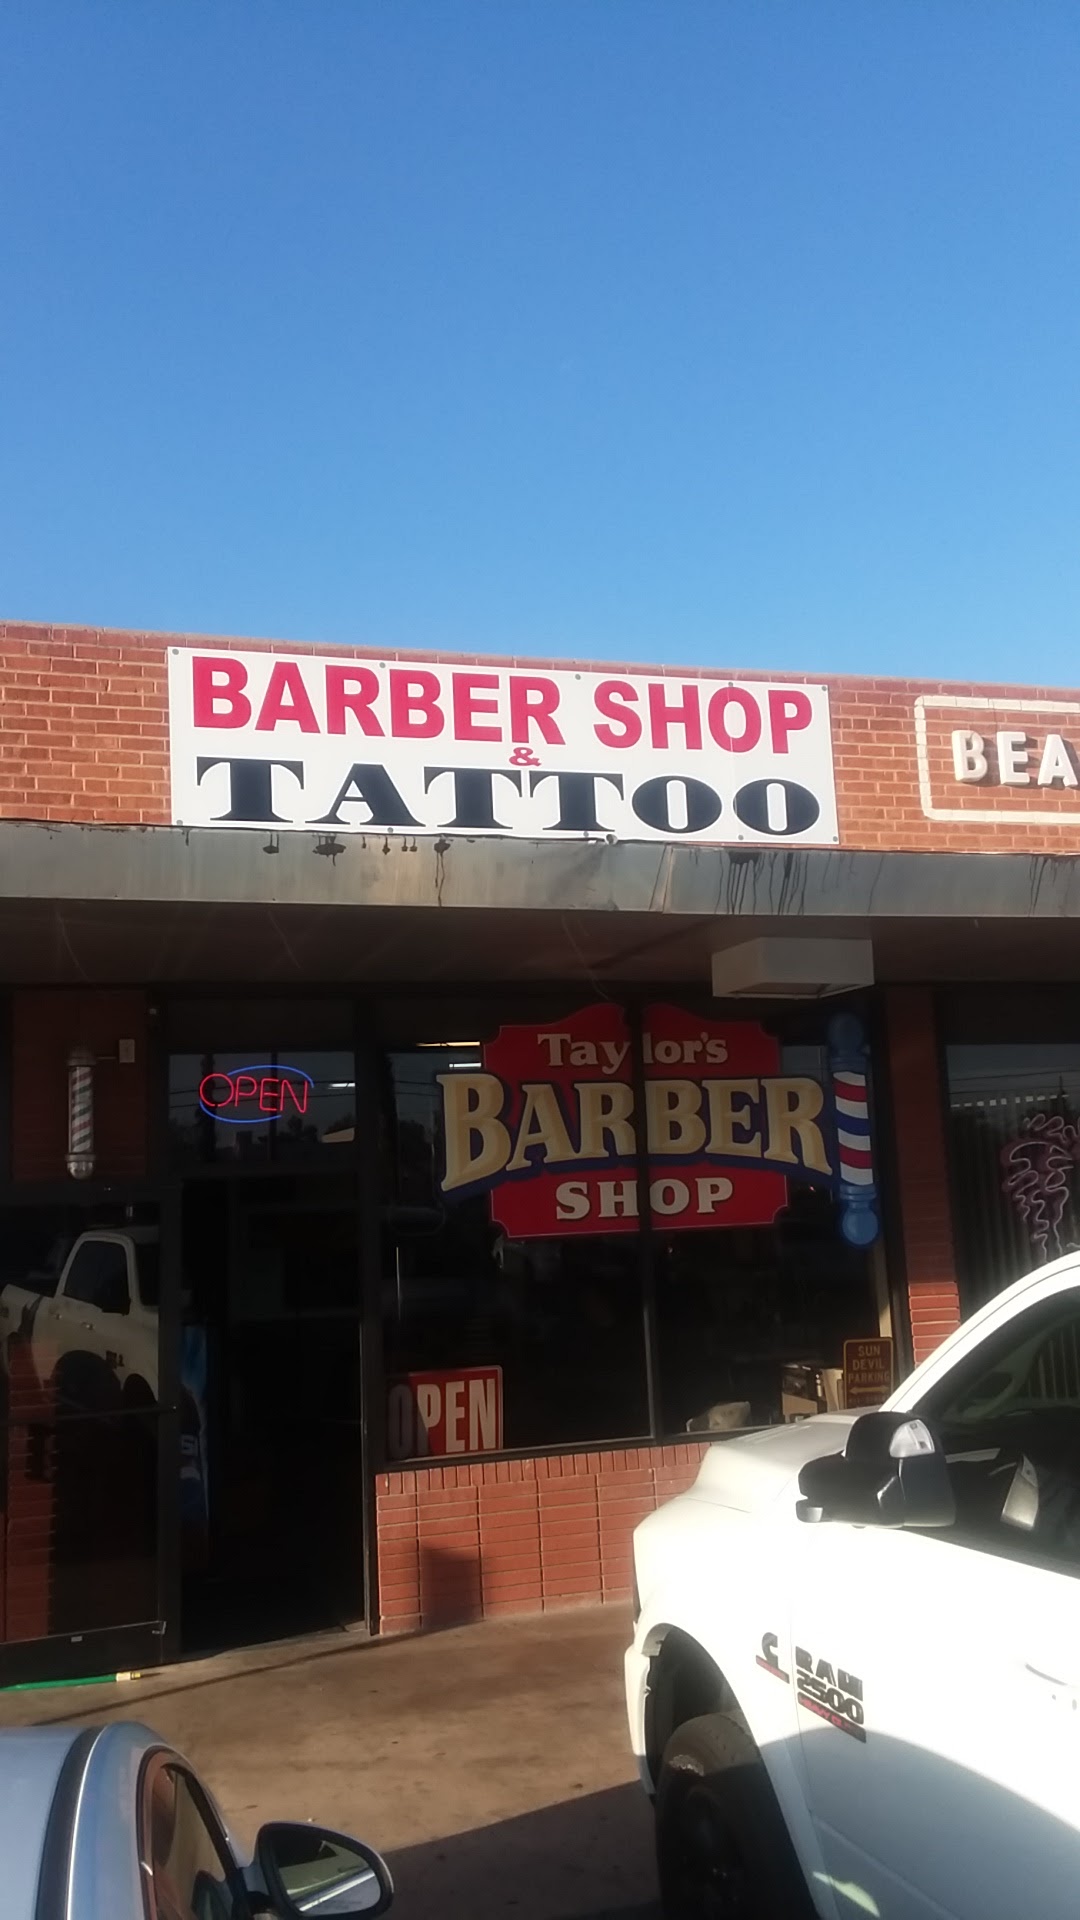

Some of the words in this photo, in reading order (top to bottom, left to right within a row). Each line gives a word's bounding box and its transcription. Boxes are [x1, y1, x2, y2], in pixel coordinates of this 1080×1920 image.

[192, 656, 566, 745] BARBER
[594, 680, 813, 754] SHOP
[508, 746, 542, 767] &
[951, 729, 1079, 788] BEA
[196, 756, 821, 836] TATTOO
[199, 1072, 309, 1114] OPEN
[436, 1073, 833, 1192] BARBER
[556, 1176, 733, 1220] SHOP
[848, 1372, 890, 1384] PARKING
[852, 1360, 885, 1371] DEVIL
[858, 1345, 880, 1358] SUN
[388, 1378, 496, 1460] OPEN
[795, 1645, 863, 1702] RAM
[796, 1668, 864, 1725] 2500
